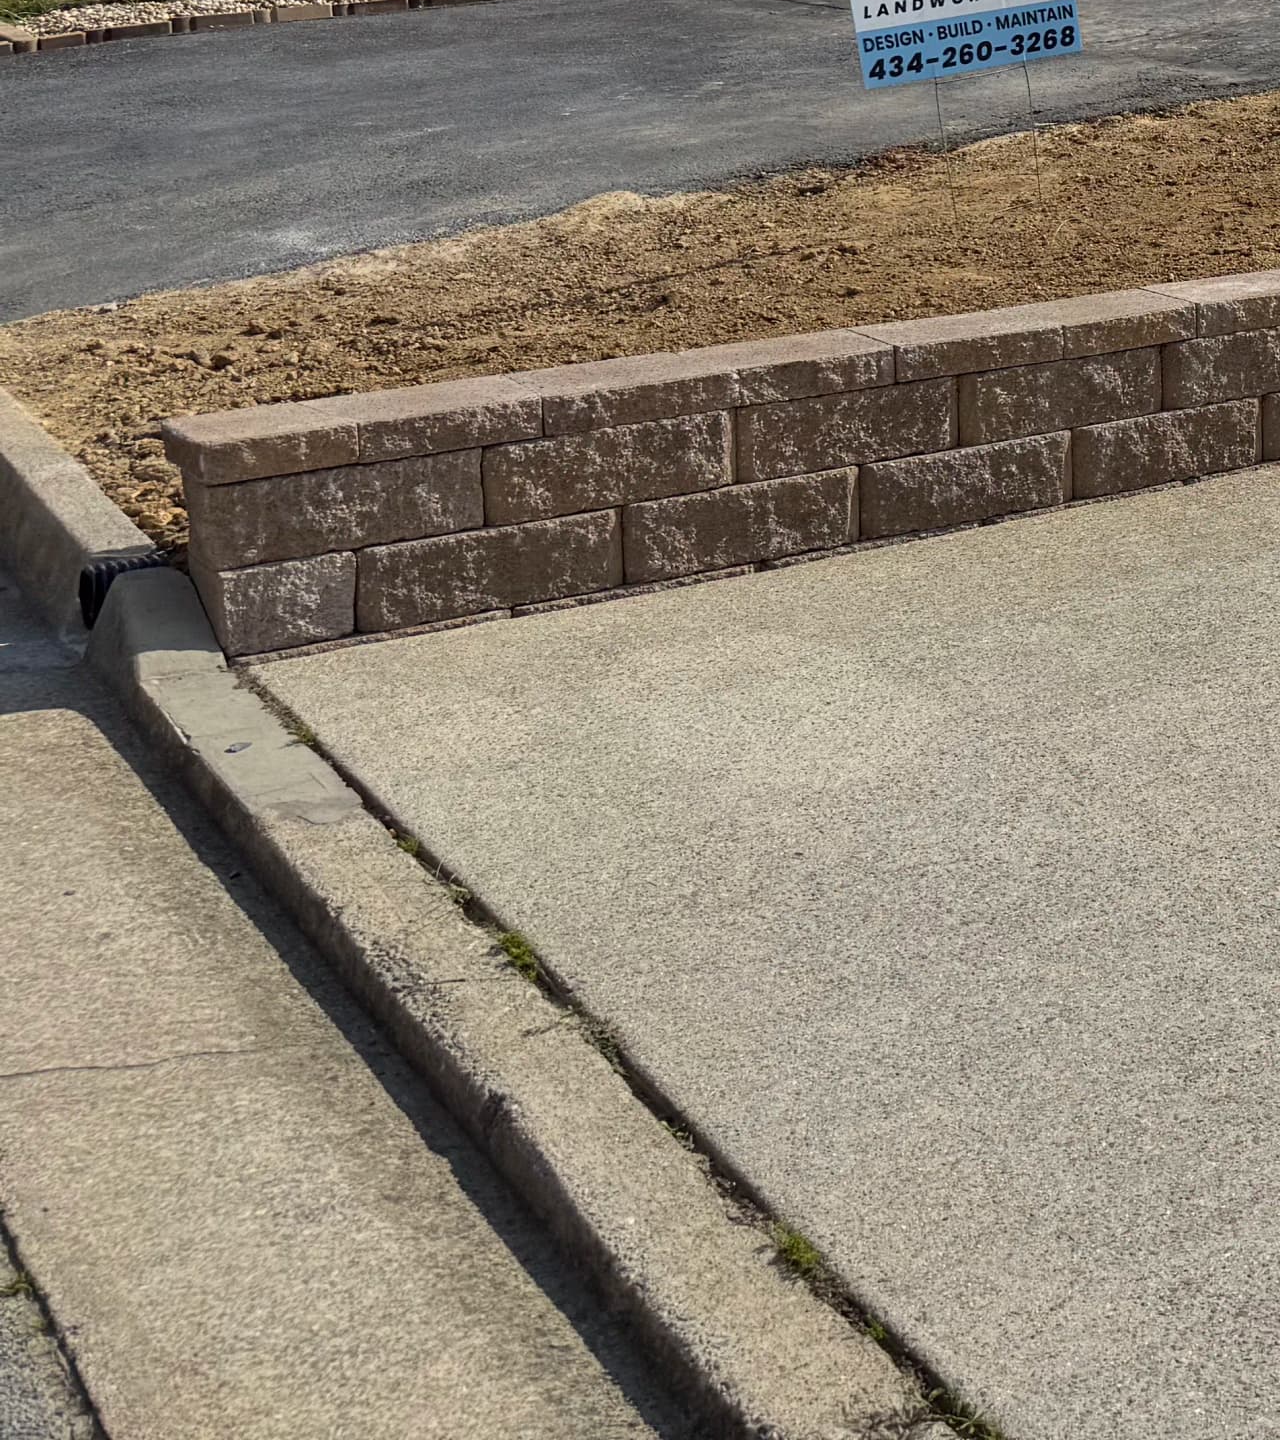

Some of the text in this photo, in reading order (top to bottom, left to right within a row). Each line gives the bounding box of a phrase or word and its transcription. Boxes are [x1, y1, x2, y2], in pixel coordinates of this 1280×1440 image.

[863, 4, 1074, 53] DESIGN BUILD MAINTAIN
[869, 26, 1075, 80] 434-260-3268
